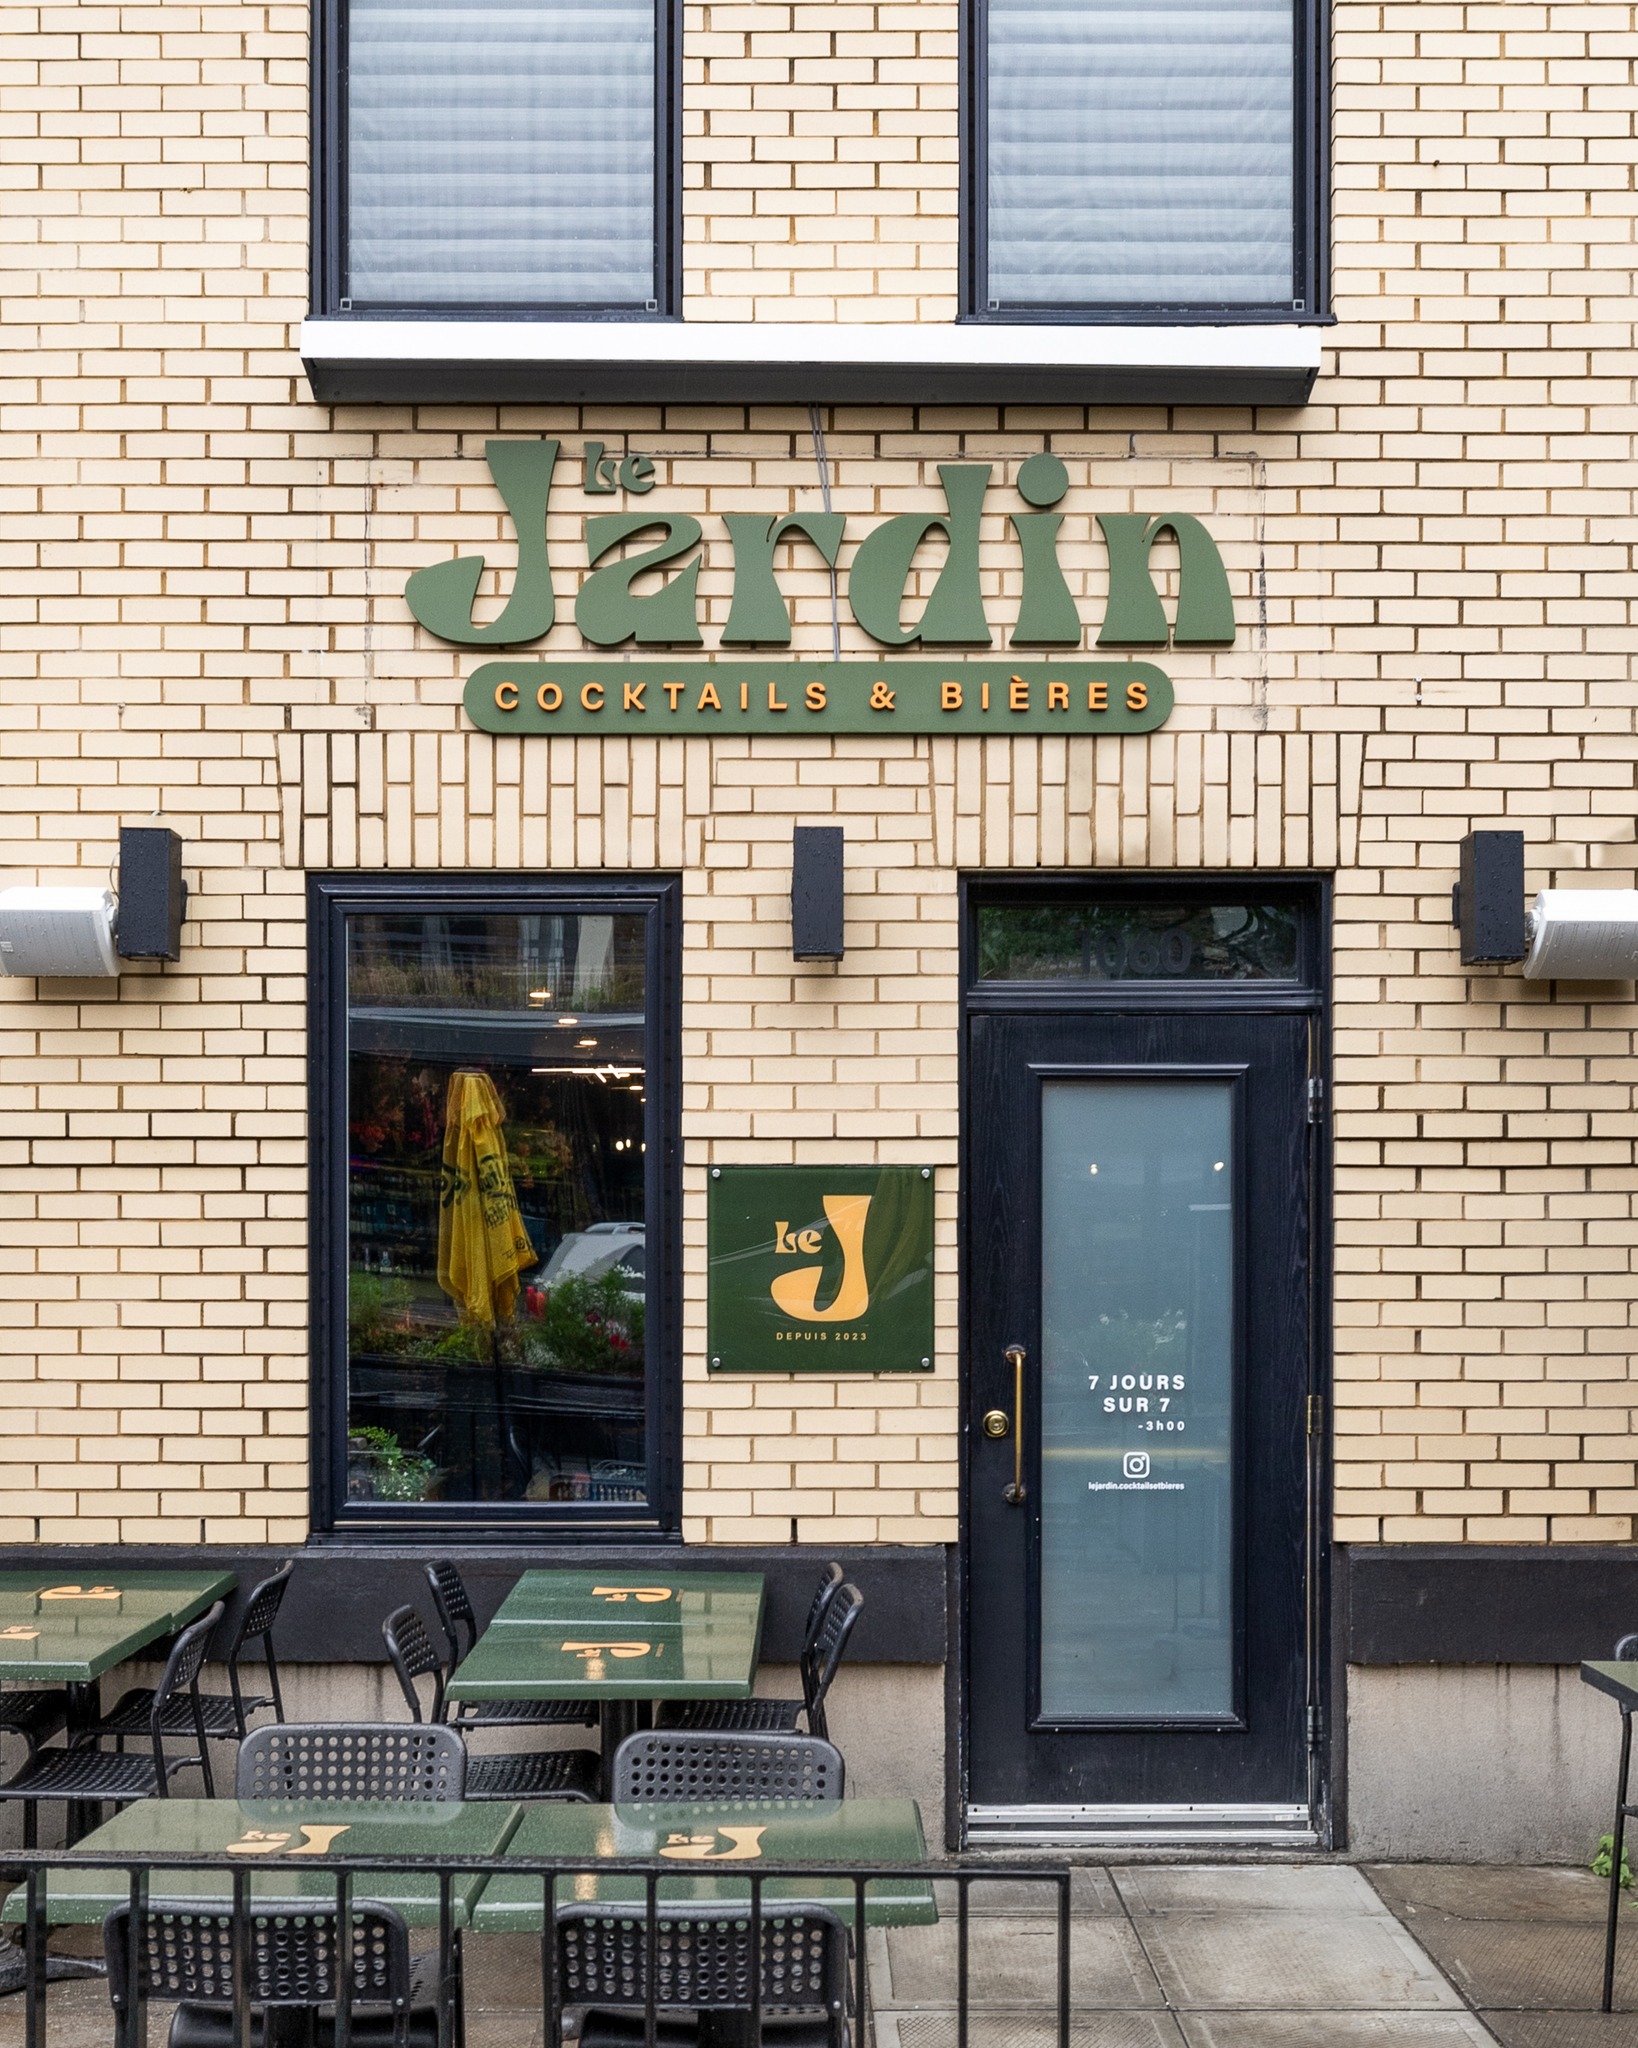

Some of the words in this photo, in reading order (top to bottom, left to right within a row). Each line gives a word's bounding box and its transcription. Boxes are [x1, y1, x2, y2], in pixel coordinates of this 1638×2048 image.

[405, 440, 1235, 645] Jardin
[494, 681, 828, 711] COCKTAILS
[869, 681, 896, 710] &
[941, 675, 1149, 711] BIÈRES
[770, 1195, 872, 1322] J
[776, 1332, 827, 1341] DEPUIS
[835, 1332, 867, 1341] 2023
[1088, 1375, 1099, 1390] 7
[1109, 1374, 1185, 1390] JOURS
[1103, 1397, 1149, 1412] SUR
[1159, 1397, 1170, 1412] 7
